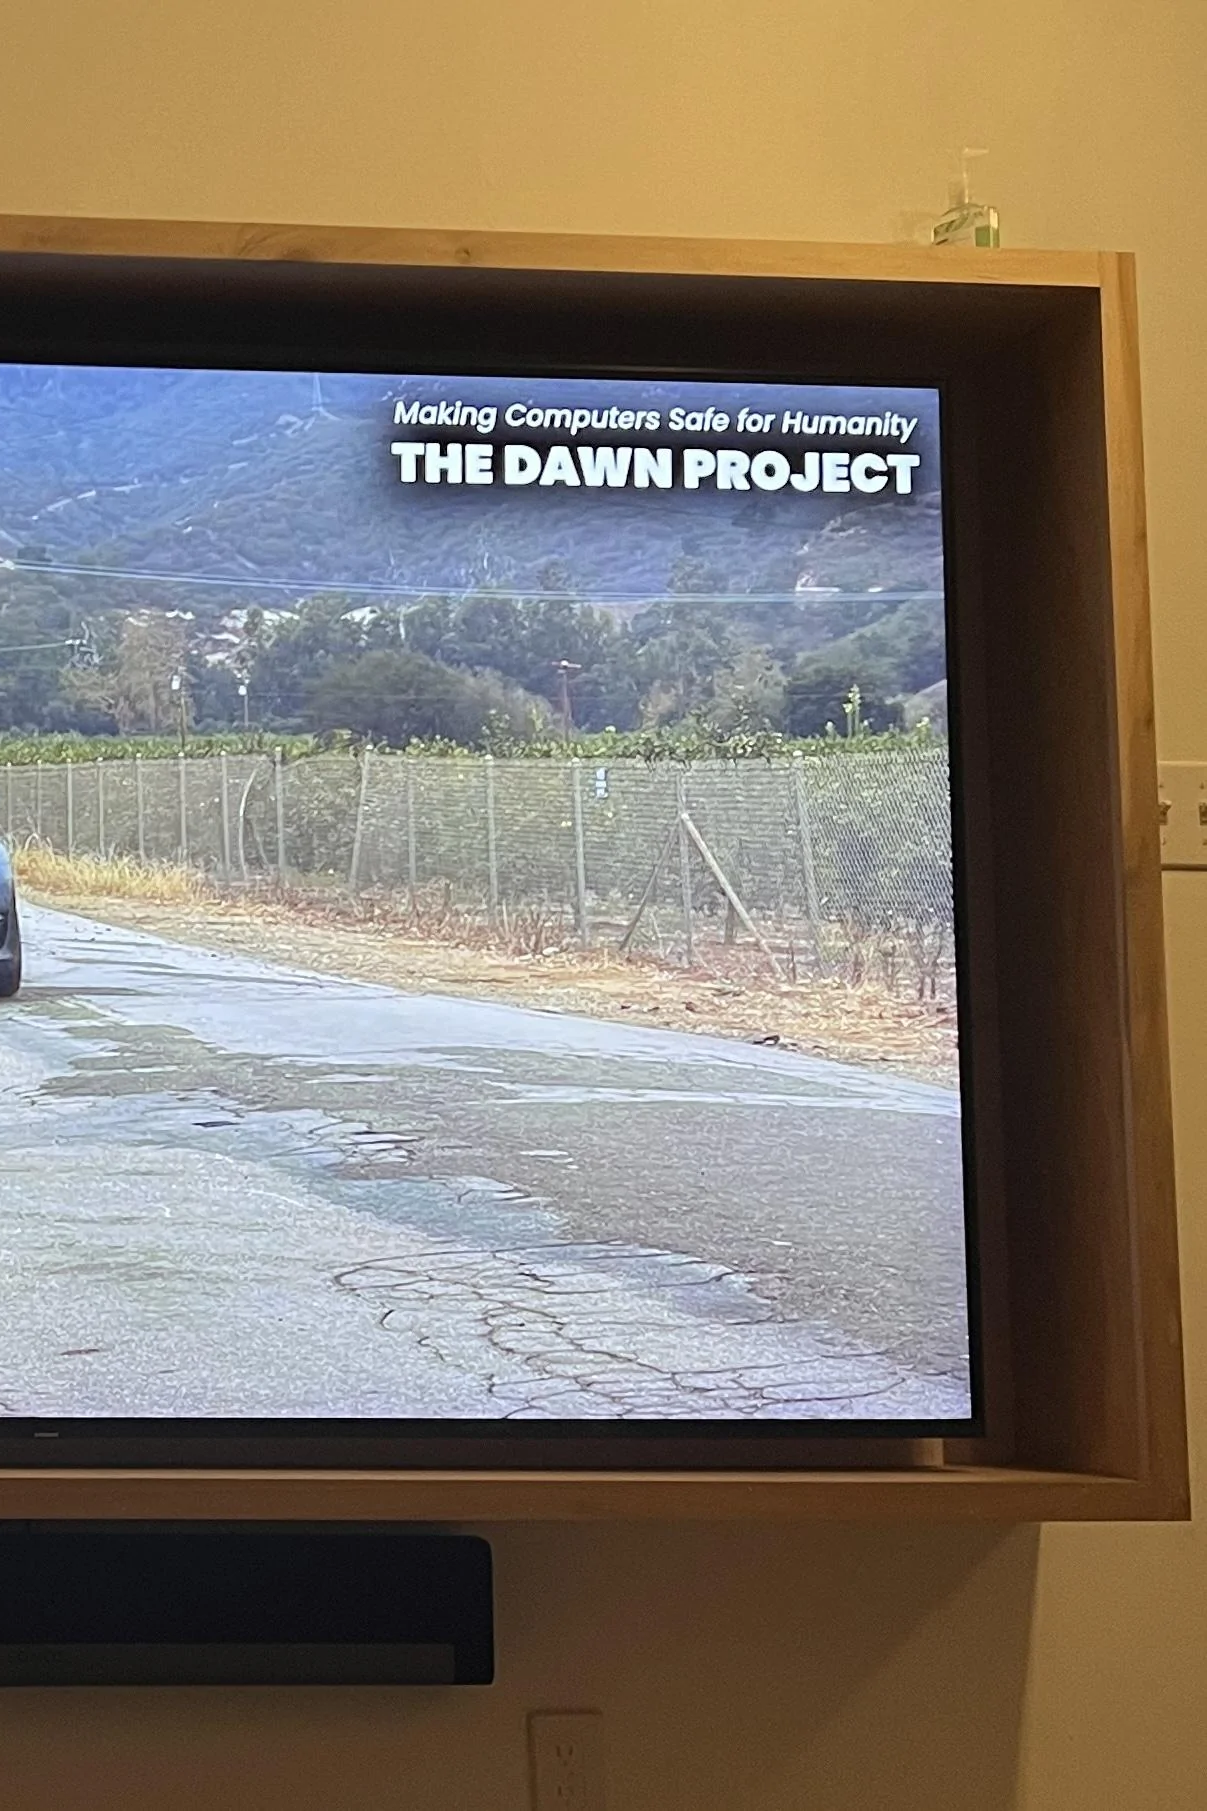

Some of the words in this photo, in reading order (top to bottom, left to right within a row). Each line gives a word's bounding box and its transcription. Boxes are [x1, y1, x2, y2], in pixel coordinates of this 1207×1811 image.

[393, 400, 497, 434] Making
[504, 403, 660, 436] Computers
[667, 407, 730, 433] Safe
[736, 408, 775, 434] for
[781, 410, 918, 444] Humanity
[391, 442, 494, 485] THE
[504, 445, 673, 489] DAWN
[683, 449, 921, 495] PROJECT
